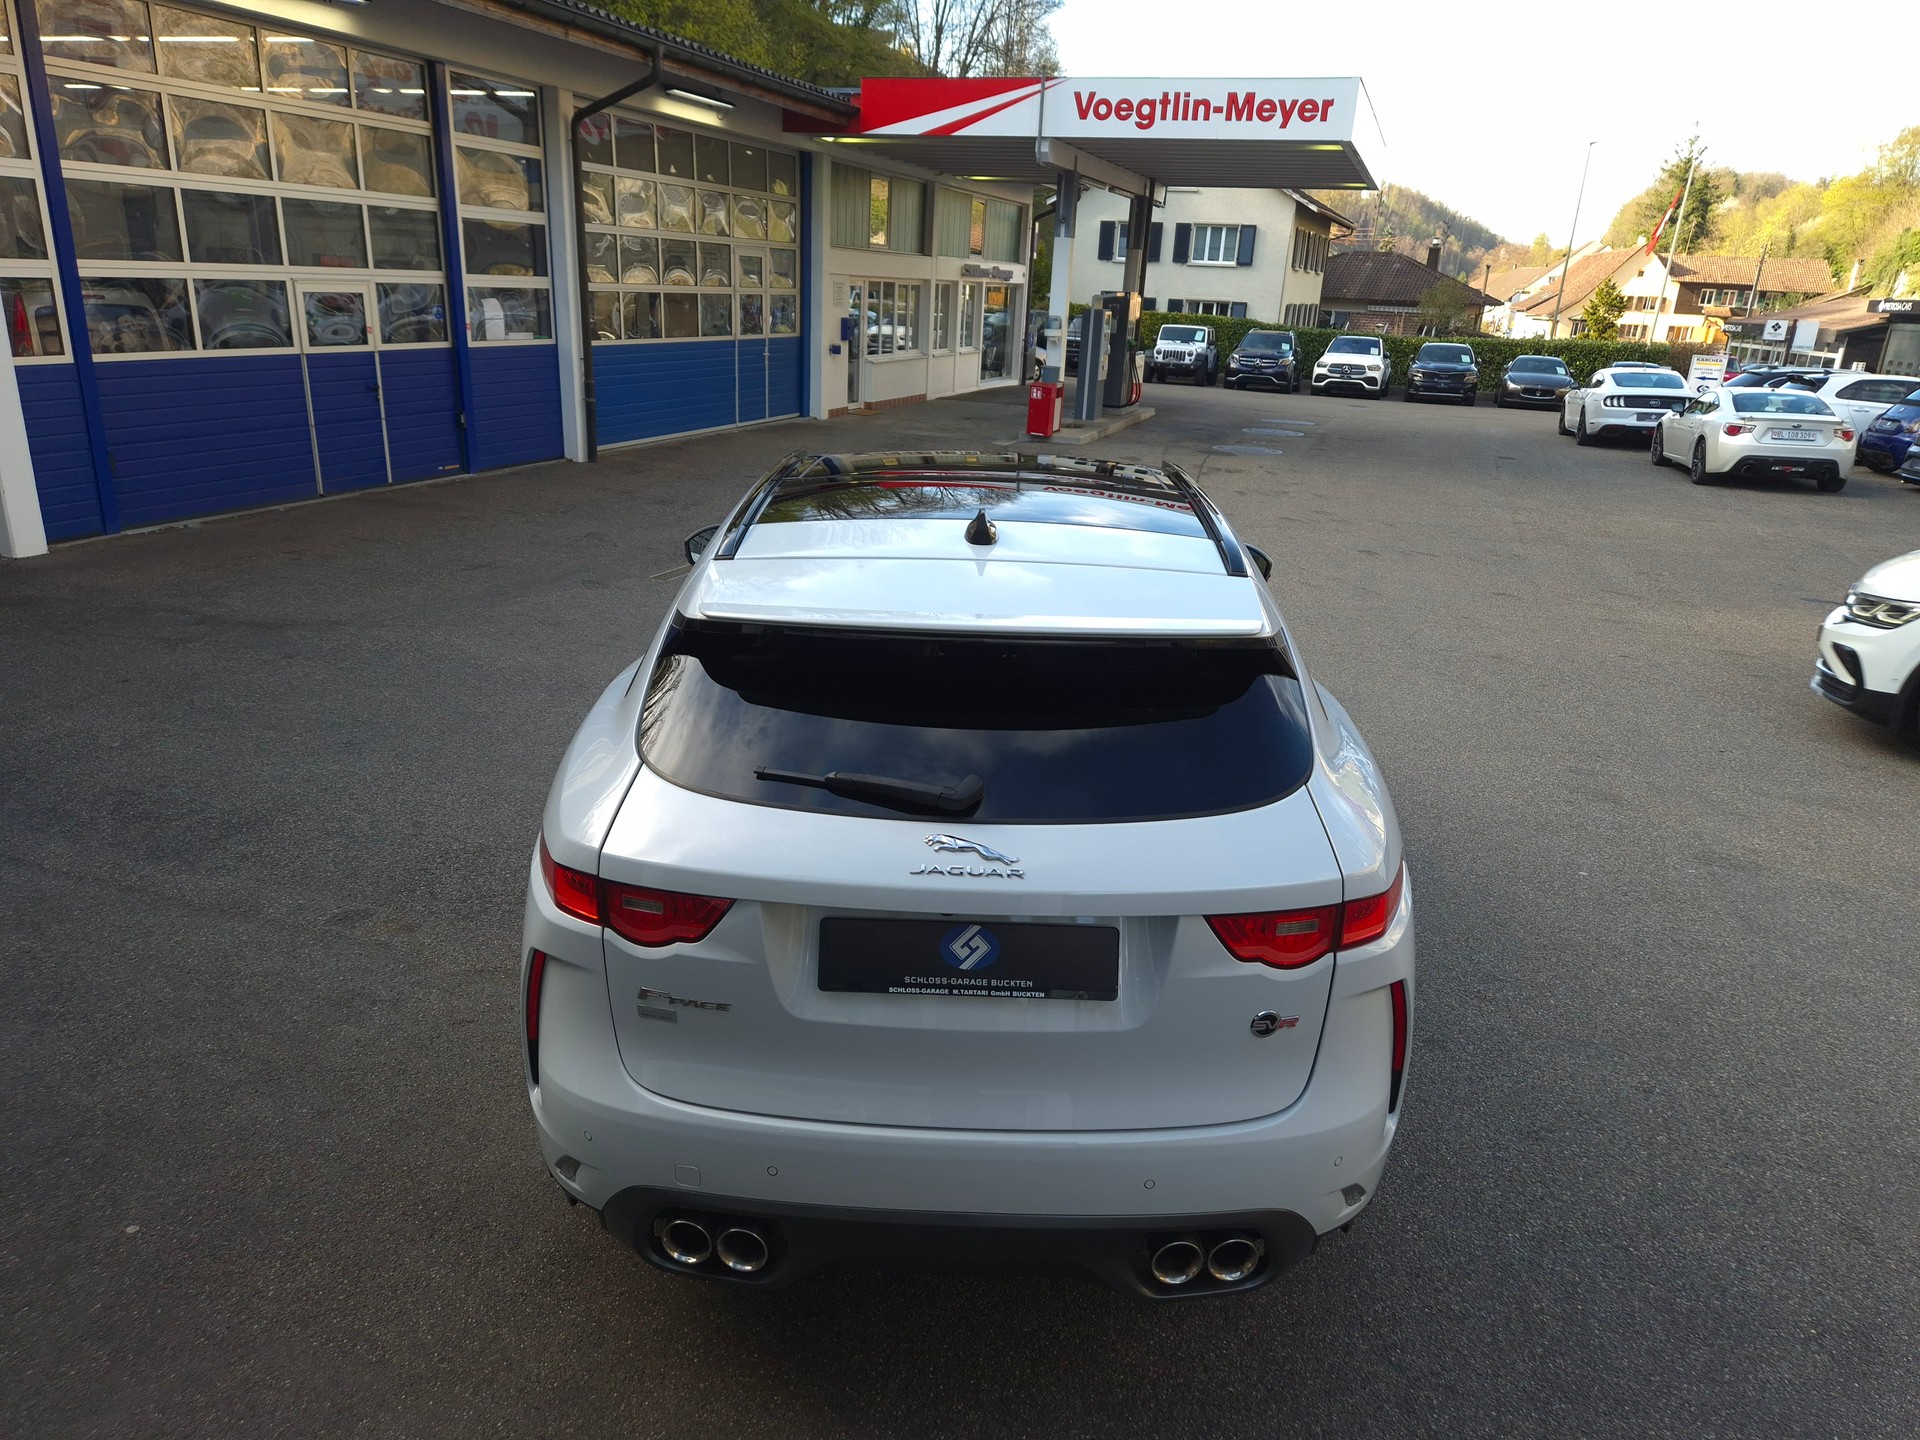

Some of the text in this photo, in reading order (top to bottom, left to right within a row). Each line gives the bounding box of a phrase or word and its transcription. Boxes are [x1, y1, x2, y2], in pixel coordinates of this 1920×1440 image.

[1073, 91, 1335, 130] Voegtlin-Meyer
[910, 864, 1025, 879] JAGUAR
[904, 975, 1033, 988] SCHLOSS-GARAGE BUCKTEN
[888, 986, 949, 995] SCHLOSS-GARAGE
